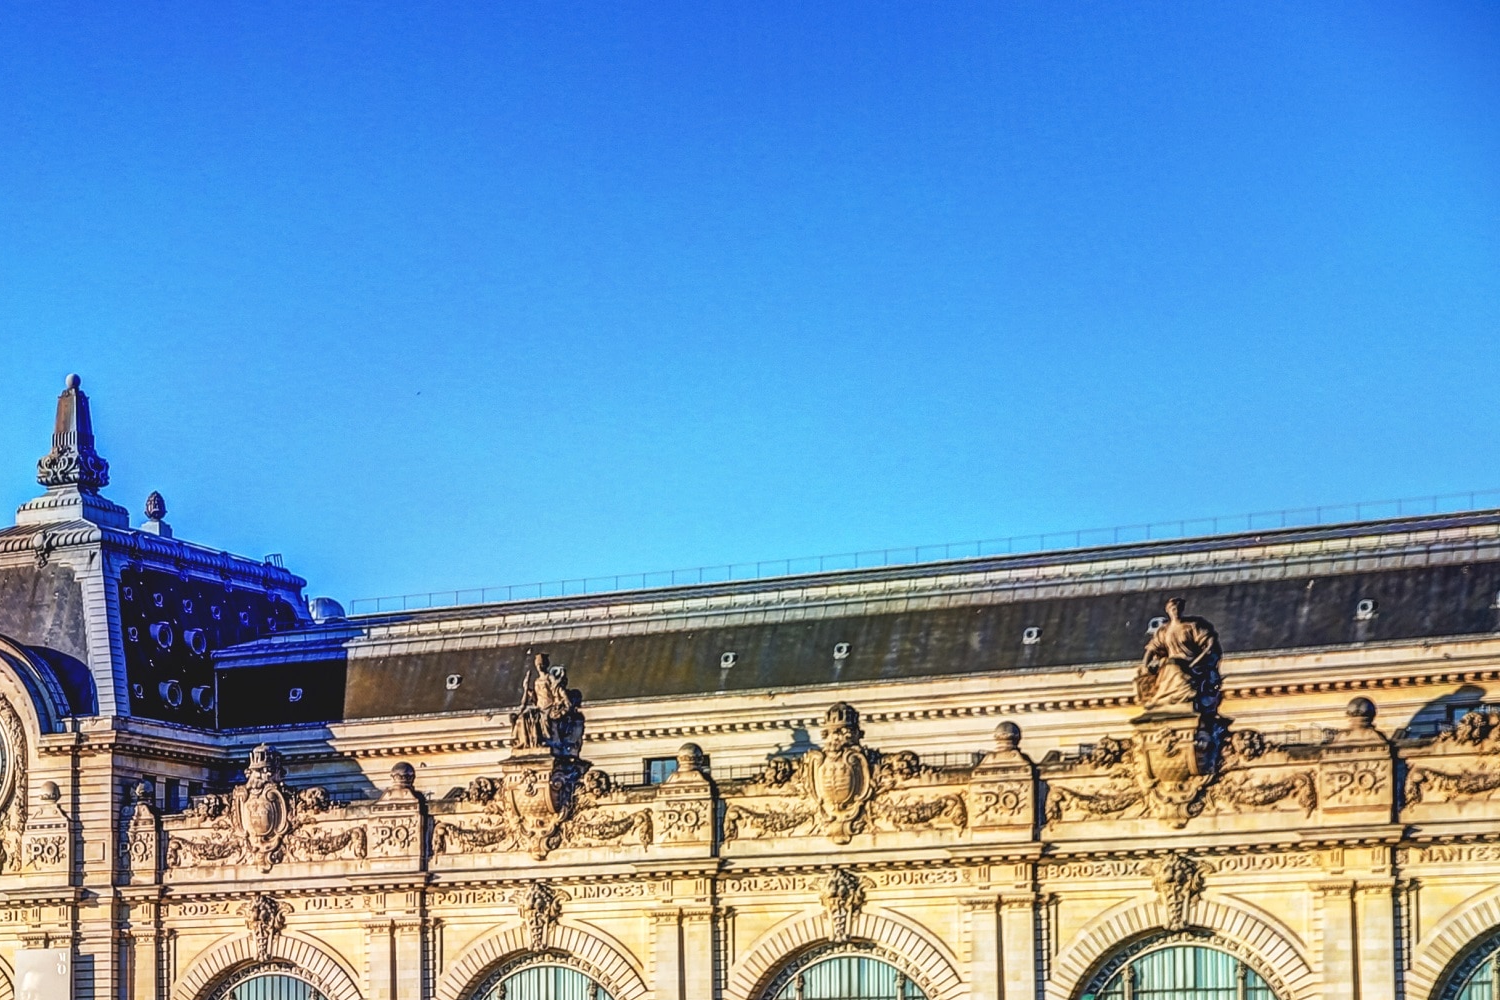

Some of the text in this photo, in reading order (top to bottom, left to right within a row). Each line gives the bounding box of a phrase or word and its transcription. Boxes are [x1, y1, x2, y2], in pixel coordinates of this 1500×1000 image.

[30, 842, 58, 859] PO
[1047, 854, 1312, 879] BORDEAUX TOULOUSE
[730, 878, 806, 892] ORLEANS
[434, 890, 506, 905] POITIERS
[177, 898, 354, 916] RODEZ TULLE
